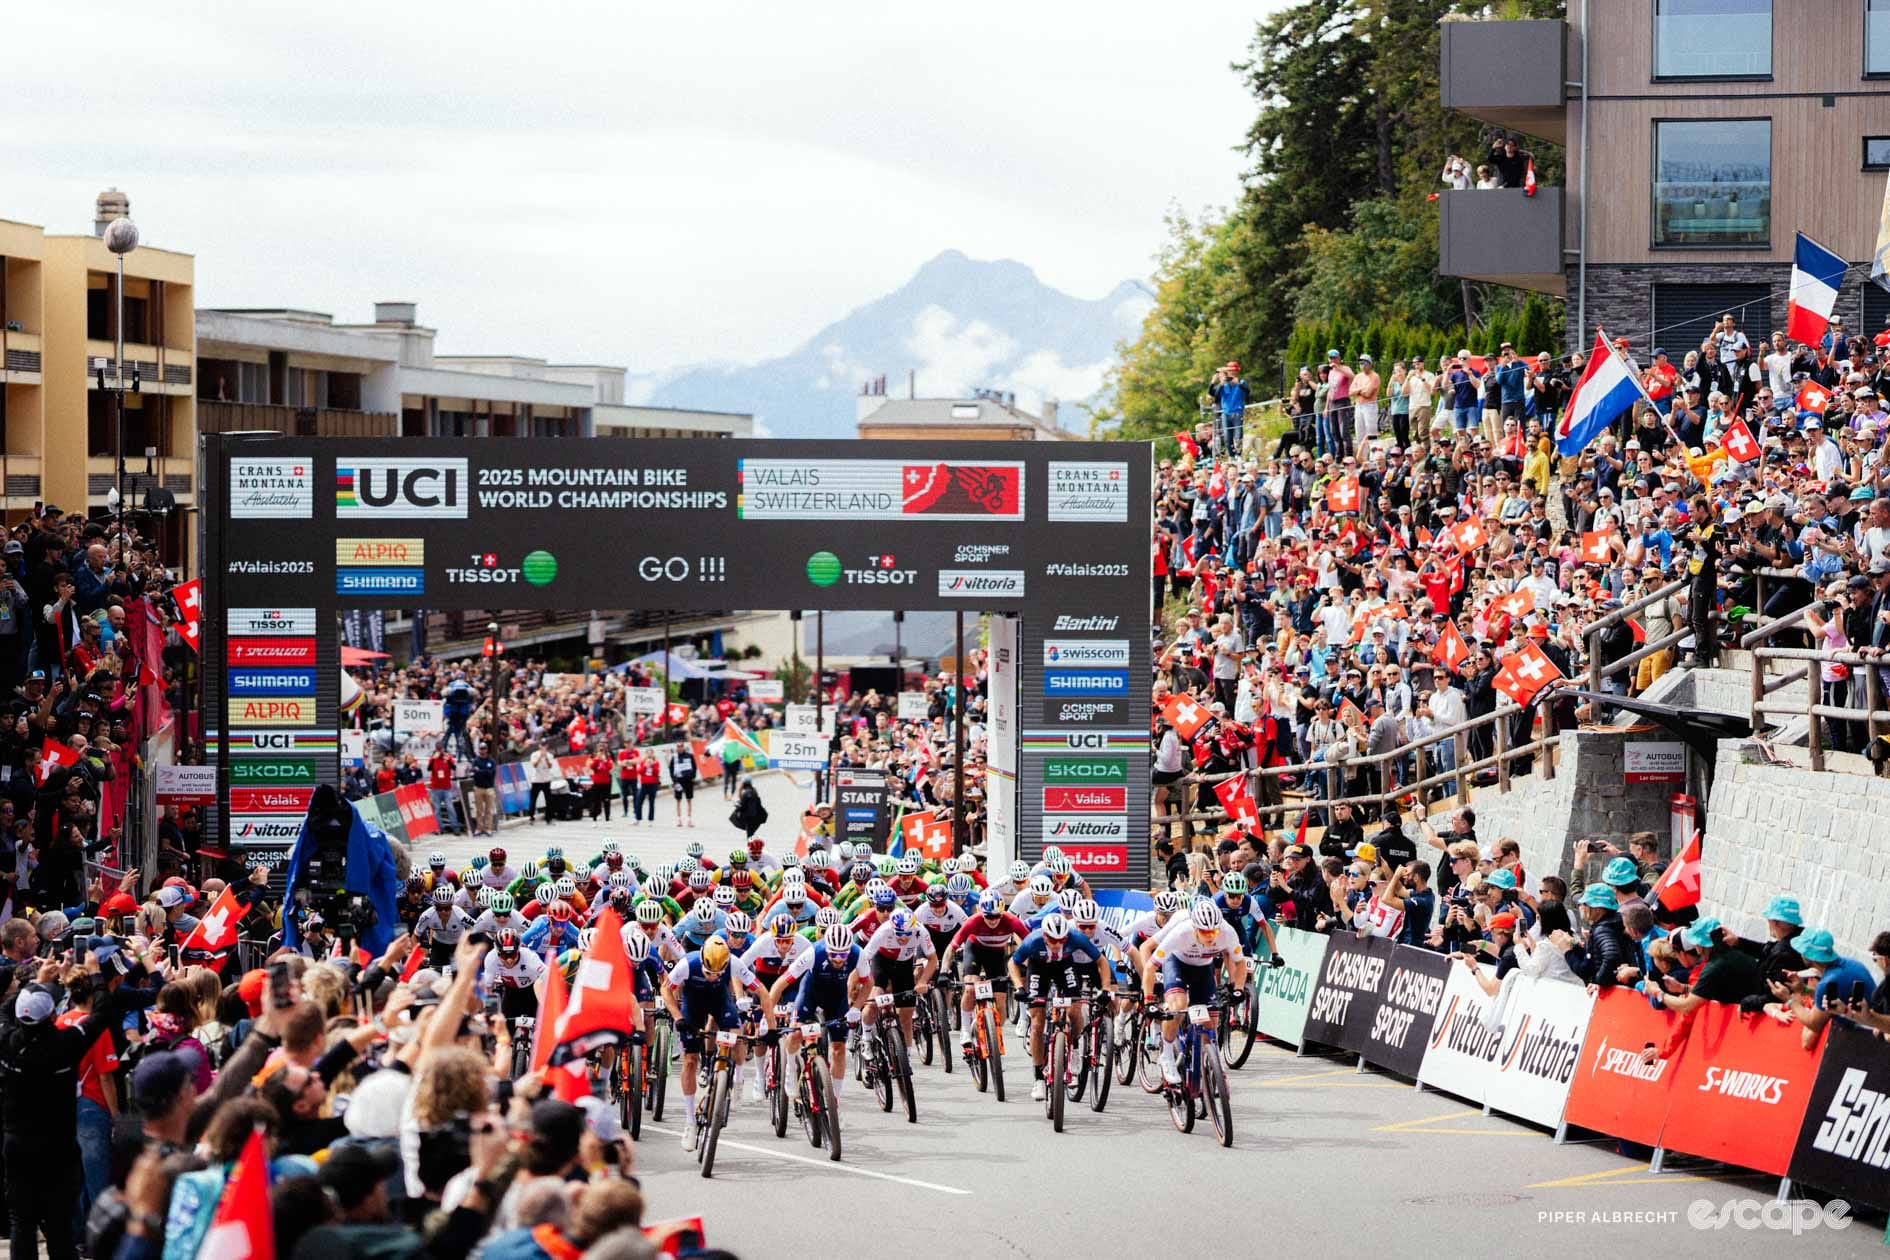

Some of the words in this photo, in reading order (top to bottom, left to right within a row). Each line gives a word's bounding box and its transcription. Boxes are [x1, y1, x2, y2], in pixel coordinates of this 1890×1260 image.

[239, 466, 283, 476] CRANS
[478, 469, 524, 486] 2025
[528, 469, 640, 486] MOUNTAIN
[644, 470, 687, 487] BIKE
[754, 469, 820, 486] VALAIS
[1057, 470, 1099, 480] CRANS
[239, 478, 304, 489] MONTANA
[359, 468, 457, 507] UCI
[1057, 483, 1120, 494] MONTANA
[241, 492, 300, 509] Absolutely
[478, 492, 553, 508] WORLD
[558, 492, 727, 510] CHAMPIONSHIPS
[754, 492, 892, 511] SWITZERLAND
[1059, 496, 1116, 512] Absolutely
[354, 544, 408, 562] ALPIQ
[958, 544, 1010, 554] OCHSNER
[954, 553, 990, 563] SPORT
[228, 561, 314, 574] #Valais2025
[638, 556, 690, 582] GO
[700, 556, 726, 582] !!!
[1046, 564, 1128, 578] #Valais2025
[344, 576, 417, 588] SHIMANO
[446, 568, 521, 583] TISSOT
[844, 570, 918, 584] TISSOT
[964, 576, 1016, 591] vittoria
[249, 620, 295, 629] TISSOT
[1054, 615, 1120, 631] Santini
[247, 647, 308, 656] SPECIALIZED
[1062, 646, 1124, 658] swisscom
[234, 676, 310, 687] SHIMANO
[1050, 677, 1123, 688] SHIMANO
[244, 702, 300, 720] ALPIQ
[403, 710, 431, 720] 50m
[1062, 704, 1114, 712] OCHSNER
[798, 714, 825, 726] 50
[1059, 712, 1094, 721] SPORT
[254, 734, 289, 748] UCI
[1069, 734, 1103, 748] UCI
[784, 743, 817, 756] 25m
[262, 794, 300, 806] Valais
[841, 792, 882, 804] START
[1075, 793, 1111, 805] Valais
[254, 823, 301, 836] vittori
[1068, 822, 1120, 835] vittoria
[1069, 852, 1119, 865] alJob
[1064, 966, 1076, 988] USA
[1326, 950, 1385, 994] OCHSNER
[1030, 974, 1040, 997] USA
[1387, 968, 1444, 1016] OCHSNER
[1312, 986, 1352, 1027] SPORT
[1370, 1004, 1415, 1050] SPORT
[1519, 1018, 1580, 1084] vittoria
[1698, 1066, 1789, 1105] S-WORKS
